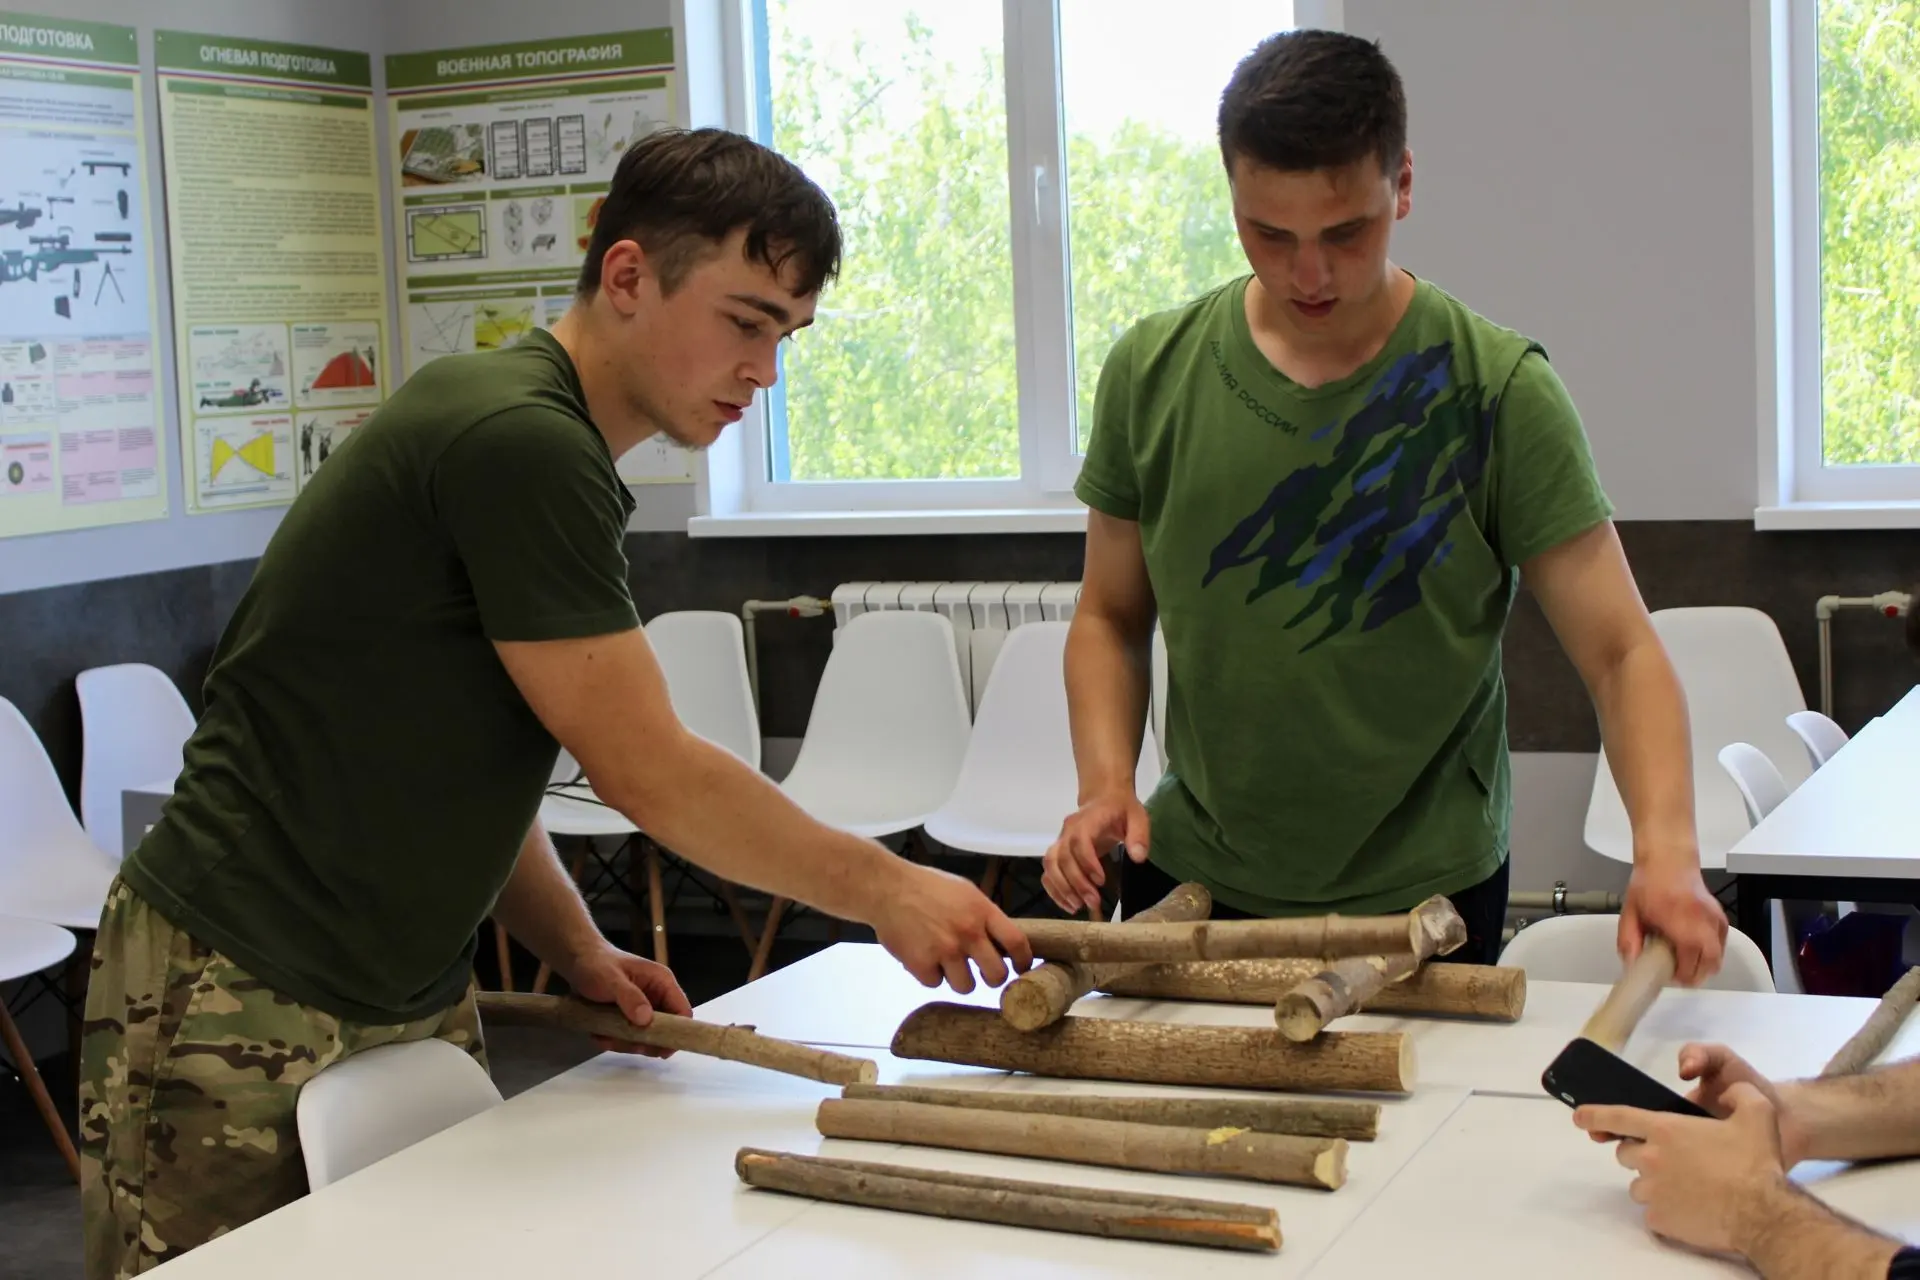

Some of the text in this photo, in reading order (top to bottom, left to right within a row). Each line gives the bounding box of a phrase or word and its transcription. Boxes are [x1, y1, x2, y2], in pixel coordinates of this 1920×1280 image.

[0, 23, 95, 51] ПОДГОТОВКА
[199, 44, 337, 75] ОГНЕВАЯ ПОДГОТОВКА
[437, 44, 623, 77] ВОЕННАЯ ТОПОГРАФИЯ
[1236, 389, 1299, 437] РОССИИ
